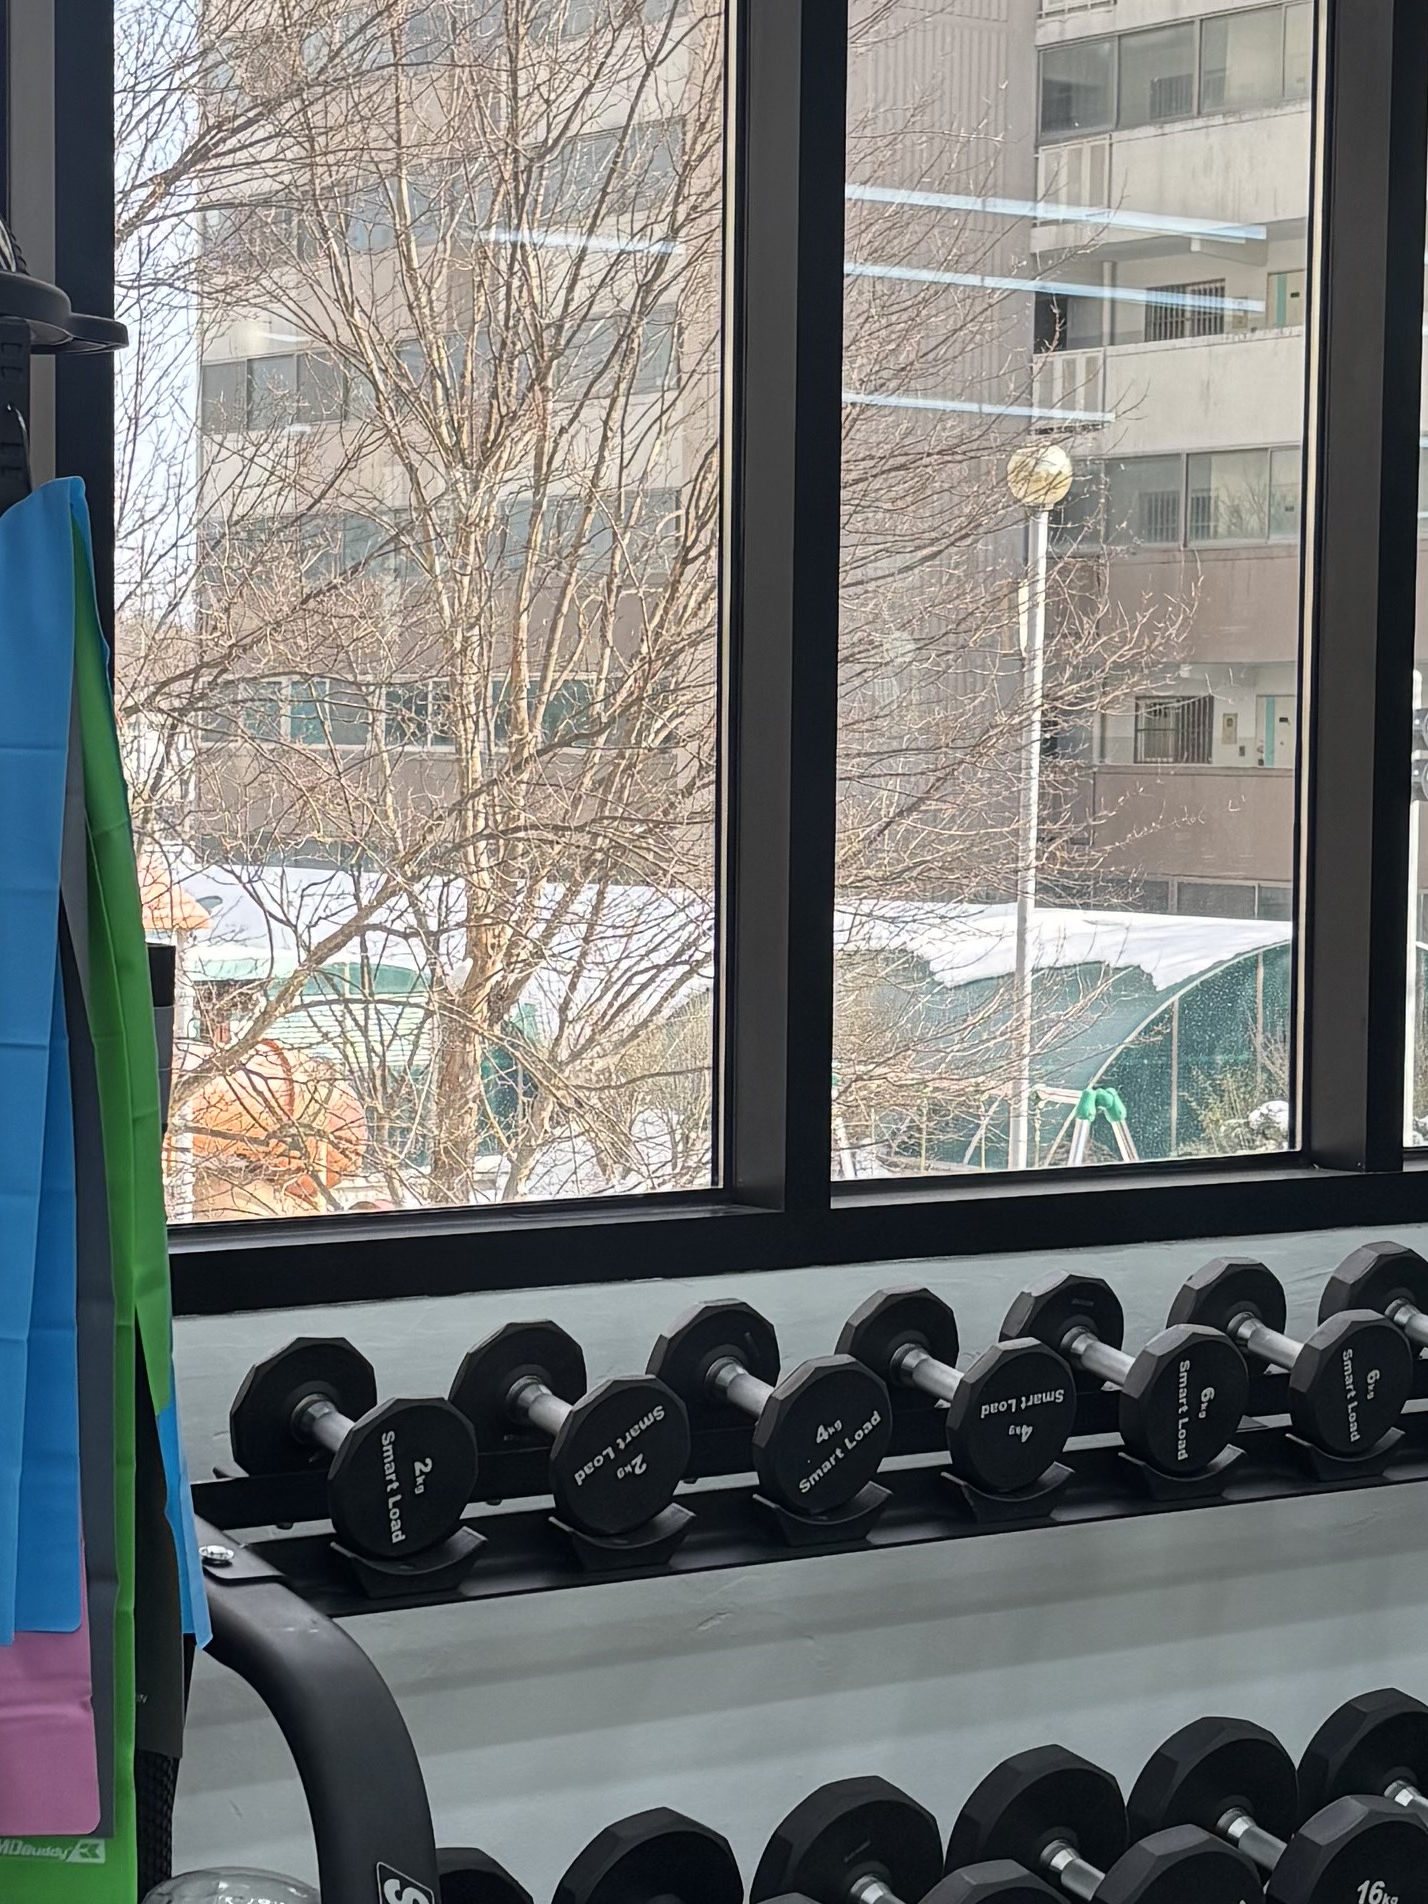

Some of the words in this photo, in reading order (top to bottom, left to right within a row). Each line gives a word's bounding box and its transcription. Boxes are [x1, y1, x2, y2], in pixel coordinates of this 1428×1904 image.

[1179, 1360, 1190, 1414] Smart
[1343, 1349, 1357, 1404] Smart
[1367, 1370, 1380, 1399] 6kg
[981, 1399, 1016, 1418] Load
[1021, 1390, 1064, 1409] Smart
[1199, 1387, 1214, 1418] 6kg
[616, 1406, 664, 1449] Smart
[816, 1420, 842, 1443] 4kg
[1009, 1425, 1032, 1442] 4kg
[1178, 1417, 1189, 1460] Load
[1348, 1402, 1360, 1441] Load
[382, 1431, 399, 1492] Smart
[575, 1447, 615, 1485] Load
[617, 1454, 646, 1478] 2kg
[799, 1448, 844, 1492] Smart
[845, 1411, 880, 1449] Load
[414, 1458, 432, 1494] 2kg
[389, 1495, 405, 1543] Load
